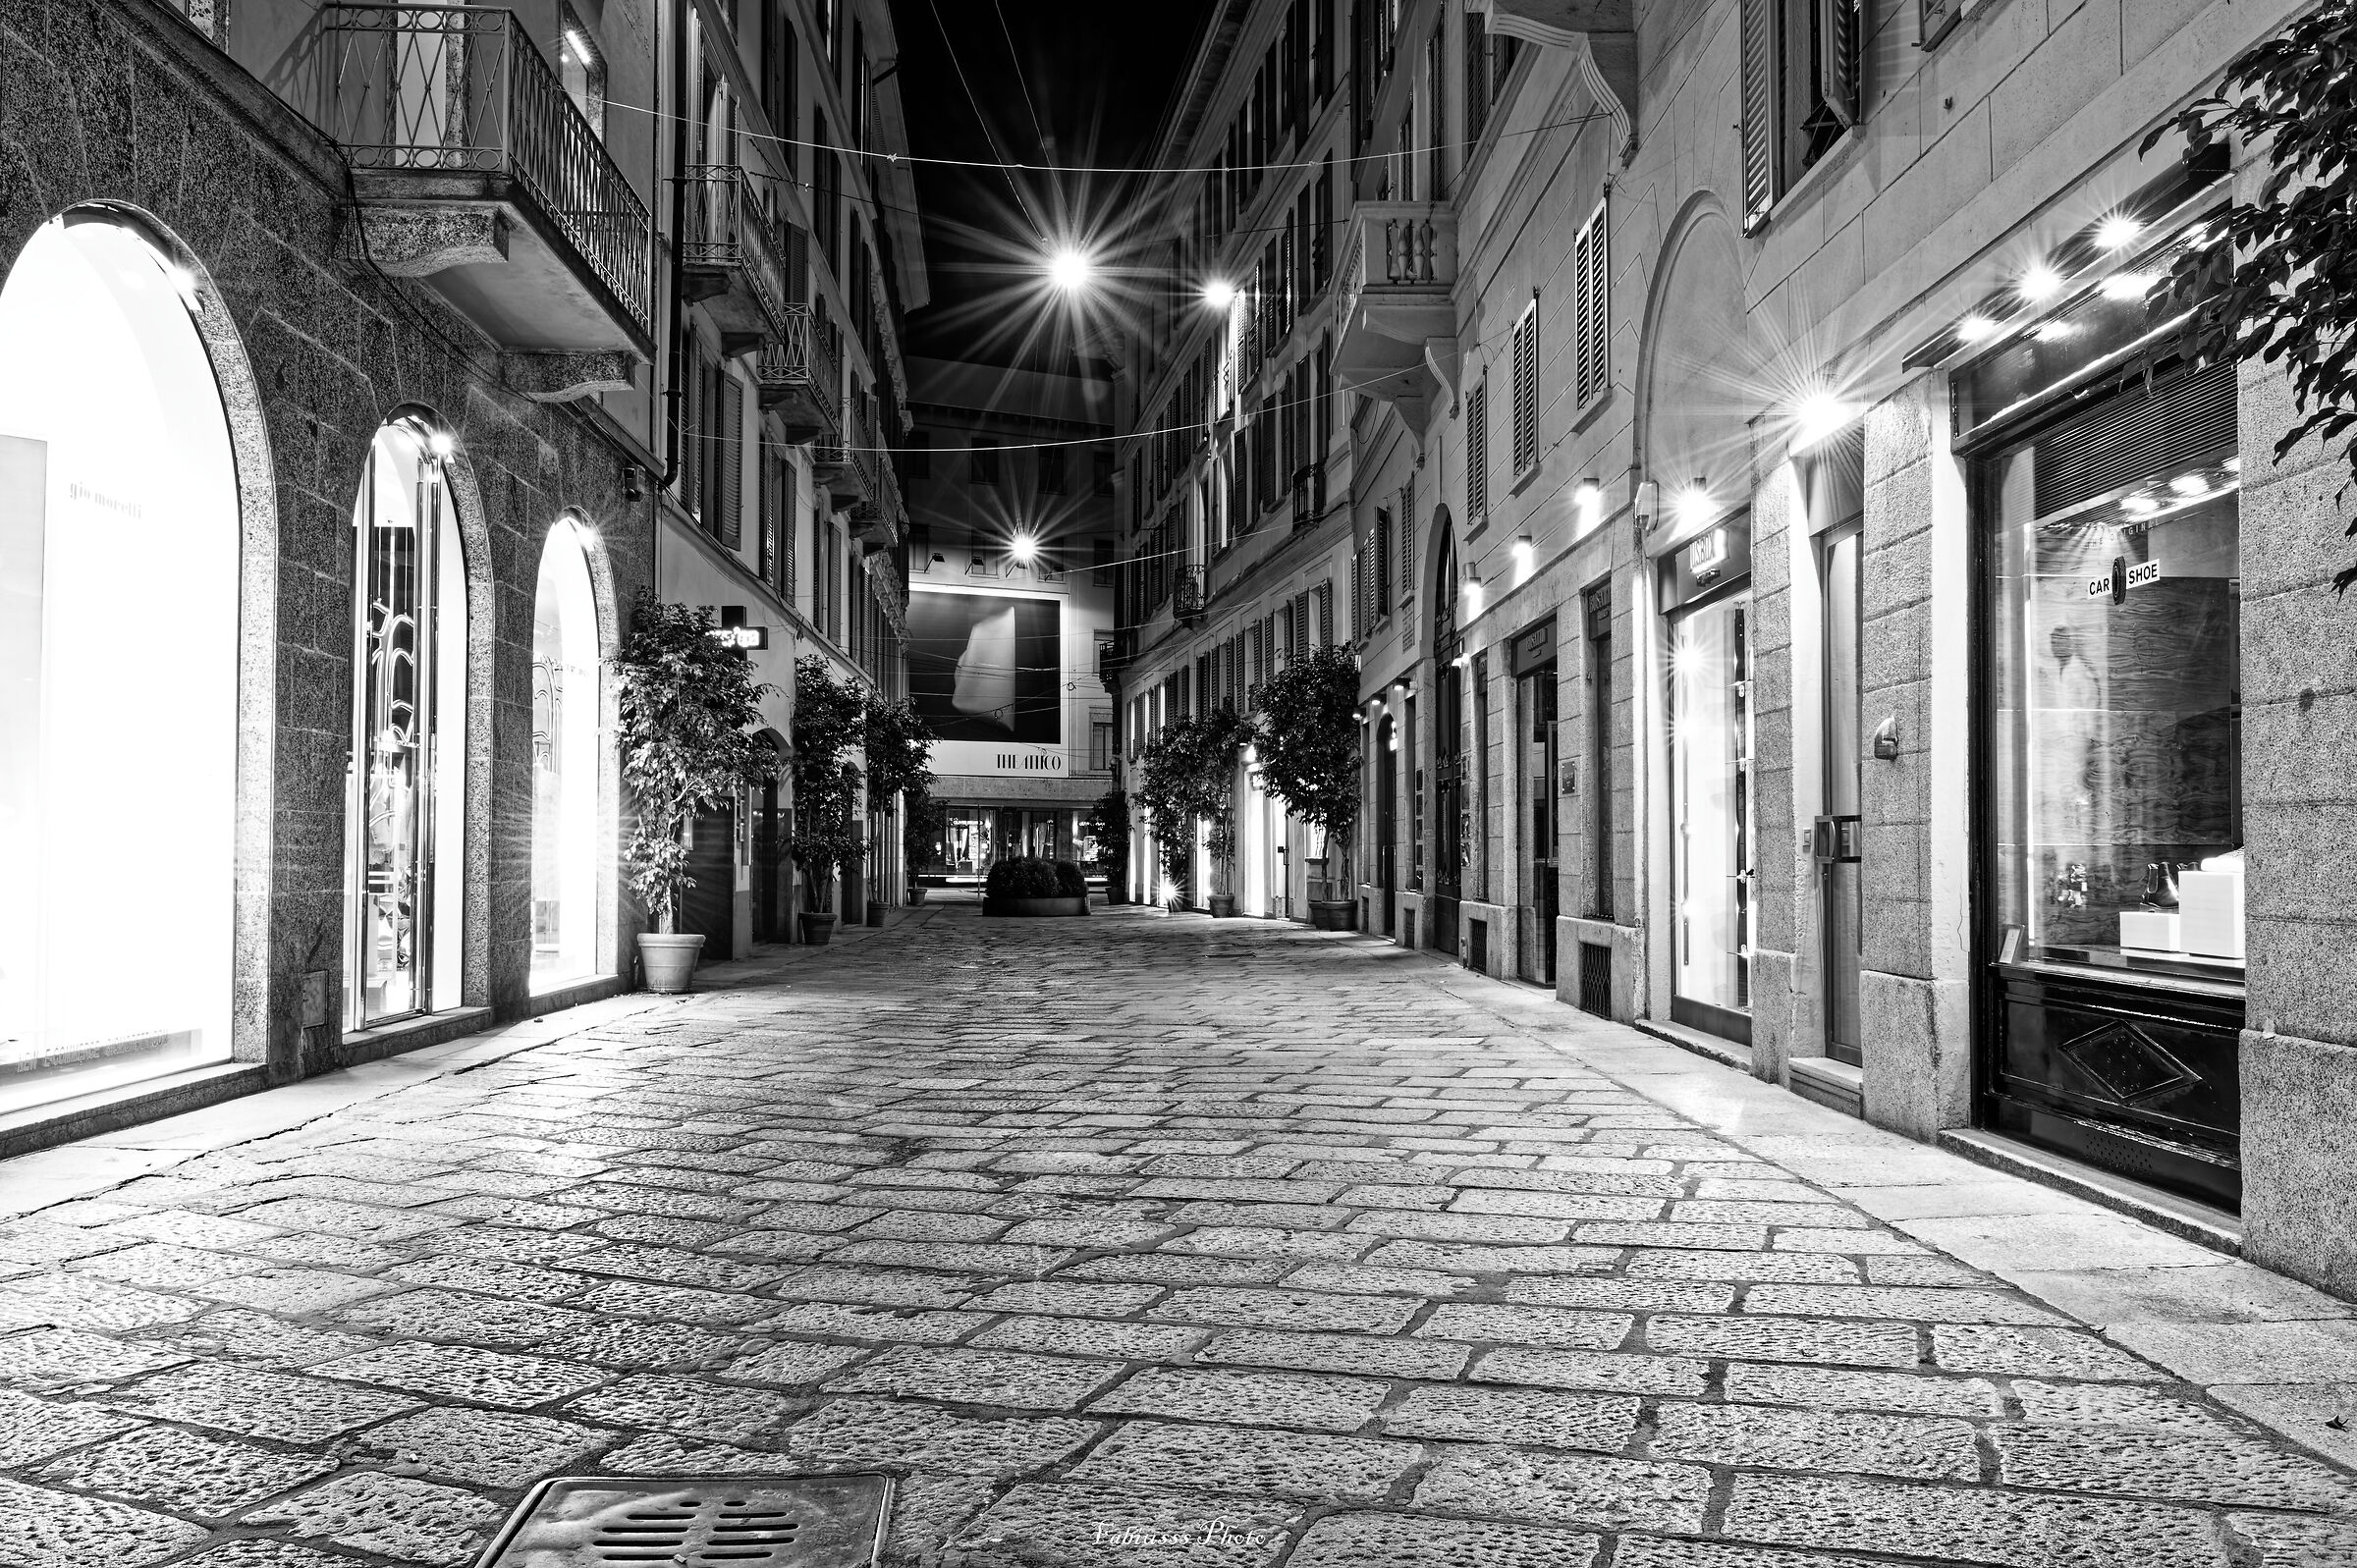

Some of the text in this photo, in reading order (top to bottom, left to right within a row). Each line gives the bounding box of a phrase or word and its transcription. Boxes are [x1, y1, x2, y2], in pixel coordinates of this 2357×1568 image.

[70, 480, 142, 520] gio moretti
[2089, 564, 2158, 595] CAR SHOE
